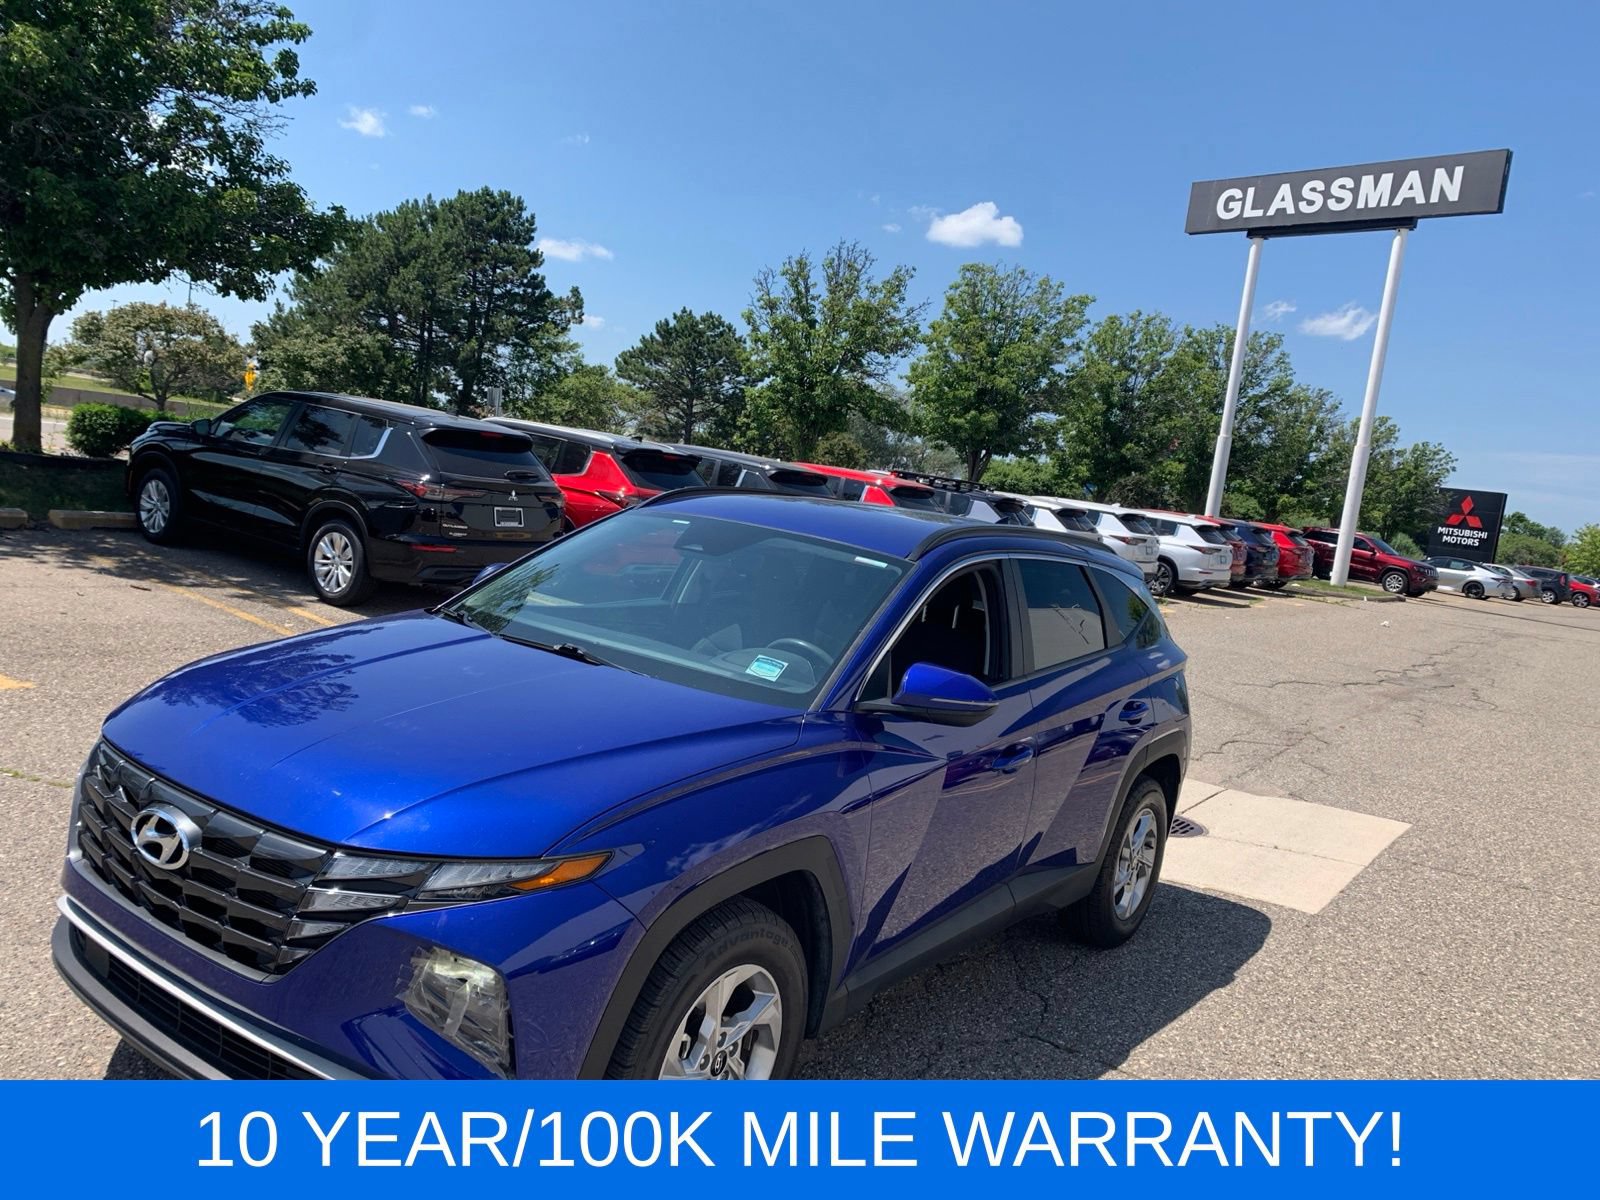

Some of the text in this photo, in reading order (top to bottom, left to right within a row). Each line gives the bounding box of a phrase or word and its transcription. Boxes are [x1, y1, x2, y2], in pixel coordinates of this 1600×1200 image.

[1216, 165, 1464, 220] GLASSMAN
[1437, 526, 1488, 539] MITSUBISHI
[1442, 535, 1480, 546] MOTORS
